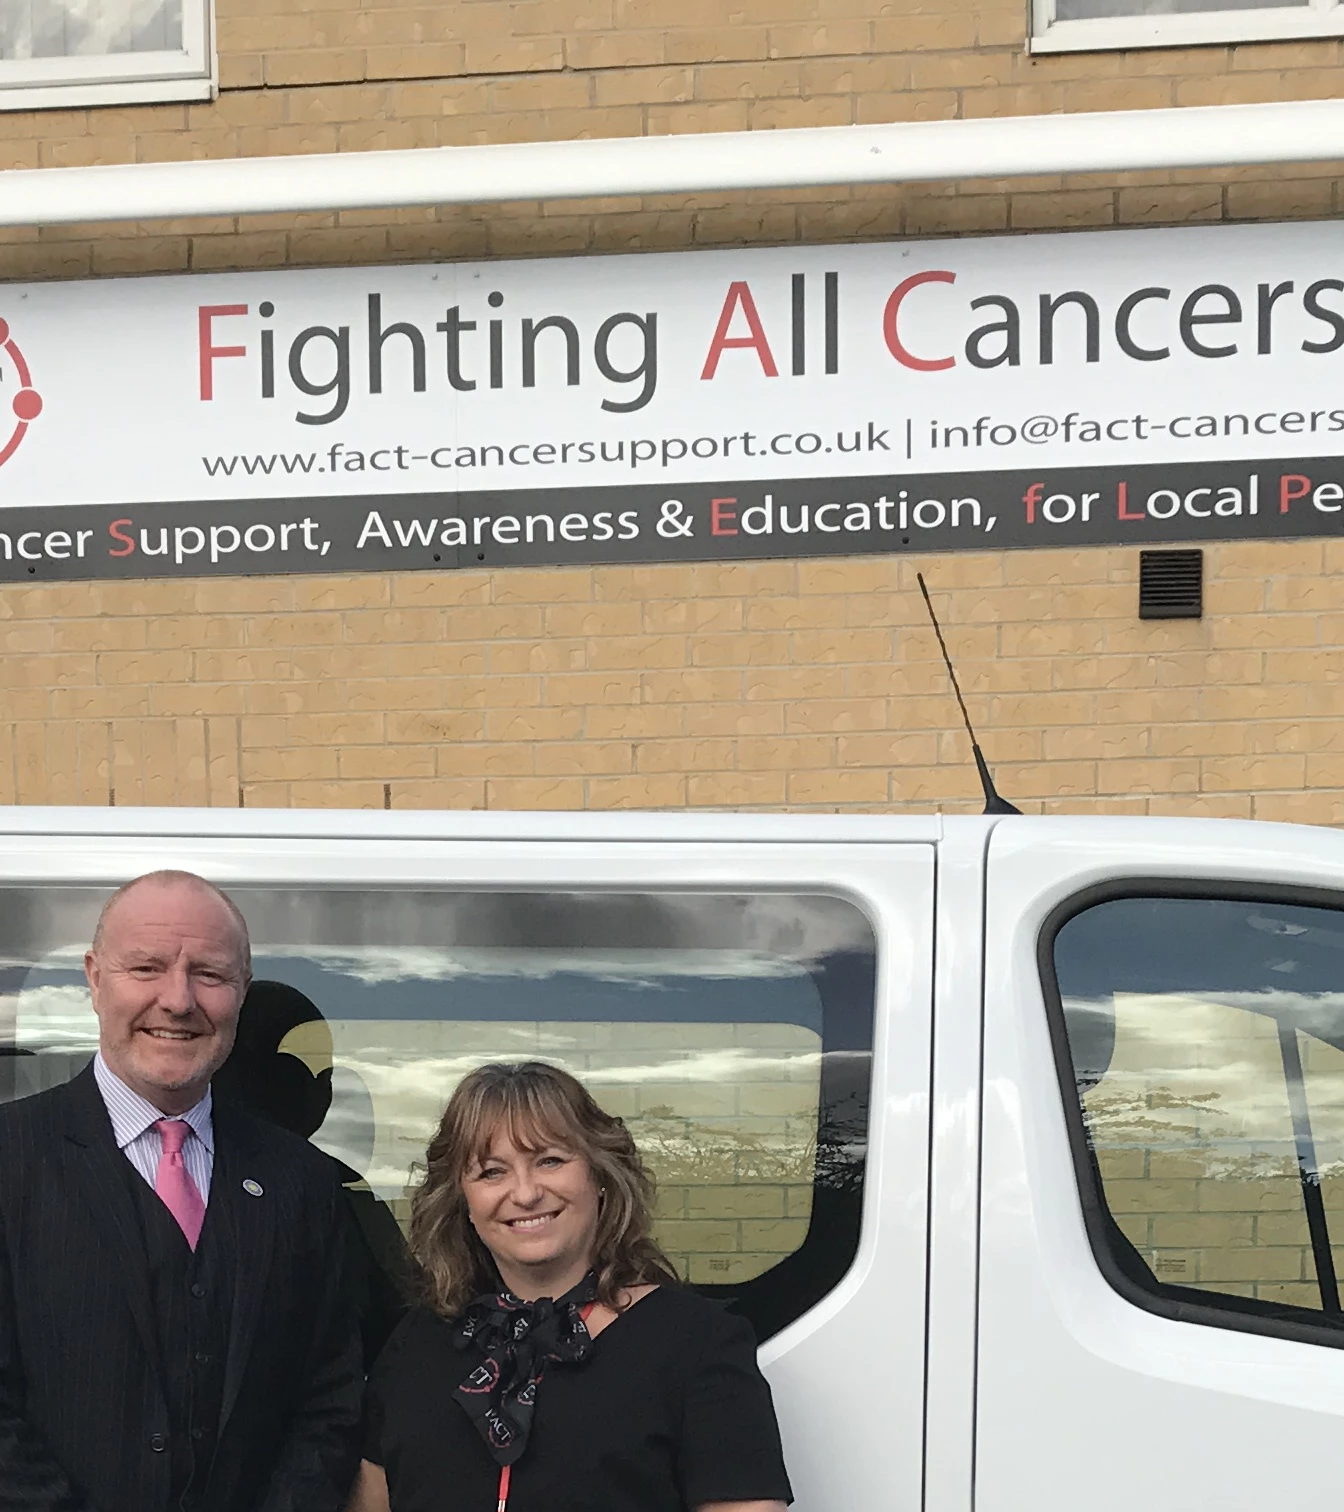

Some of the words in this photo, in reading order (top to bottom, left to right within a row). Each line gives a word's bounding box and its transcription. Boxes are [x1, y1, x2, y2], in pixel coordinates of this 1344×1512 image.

[198, 290, 658, 426] Fighting
[700, 271, 839, 381] All
[201, 420, 891, 477] www.fact-cancersupport.co.uk
[109, 517, 331, 564] Support,
[356, 511, 640, 549] Awareness
[655, 499, 694, 538] &
[711, 490, 998, 537] Education,
[1022, 482, 1100, 524] for
[1118, 474, 1259, 520] Local
